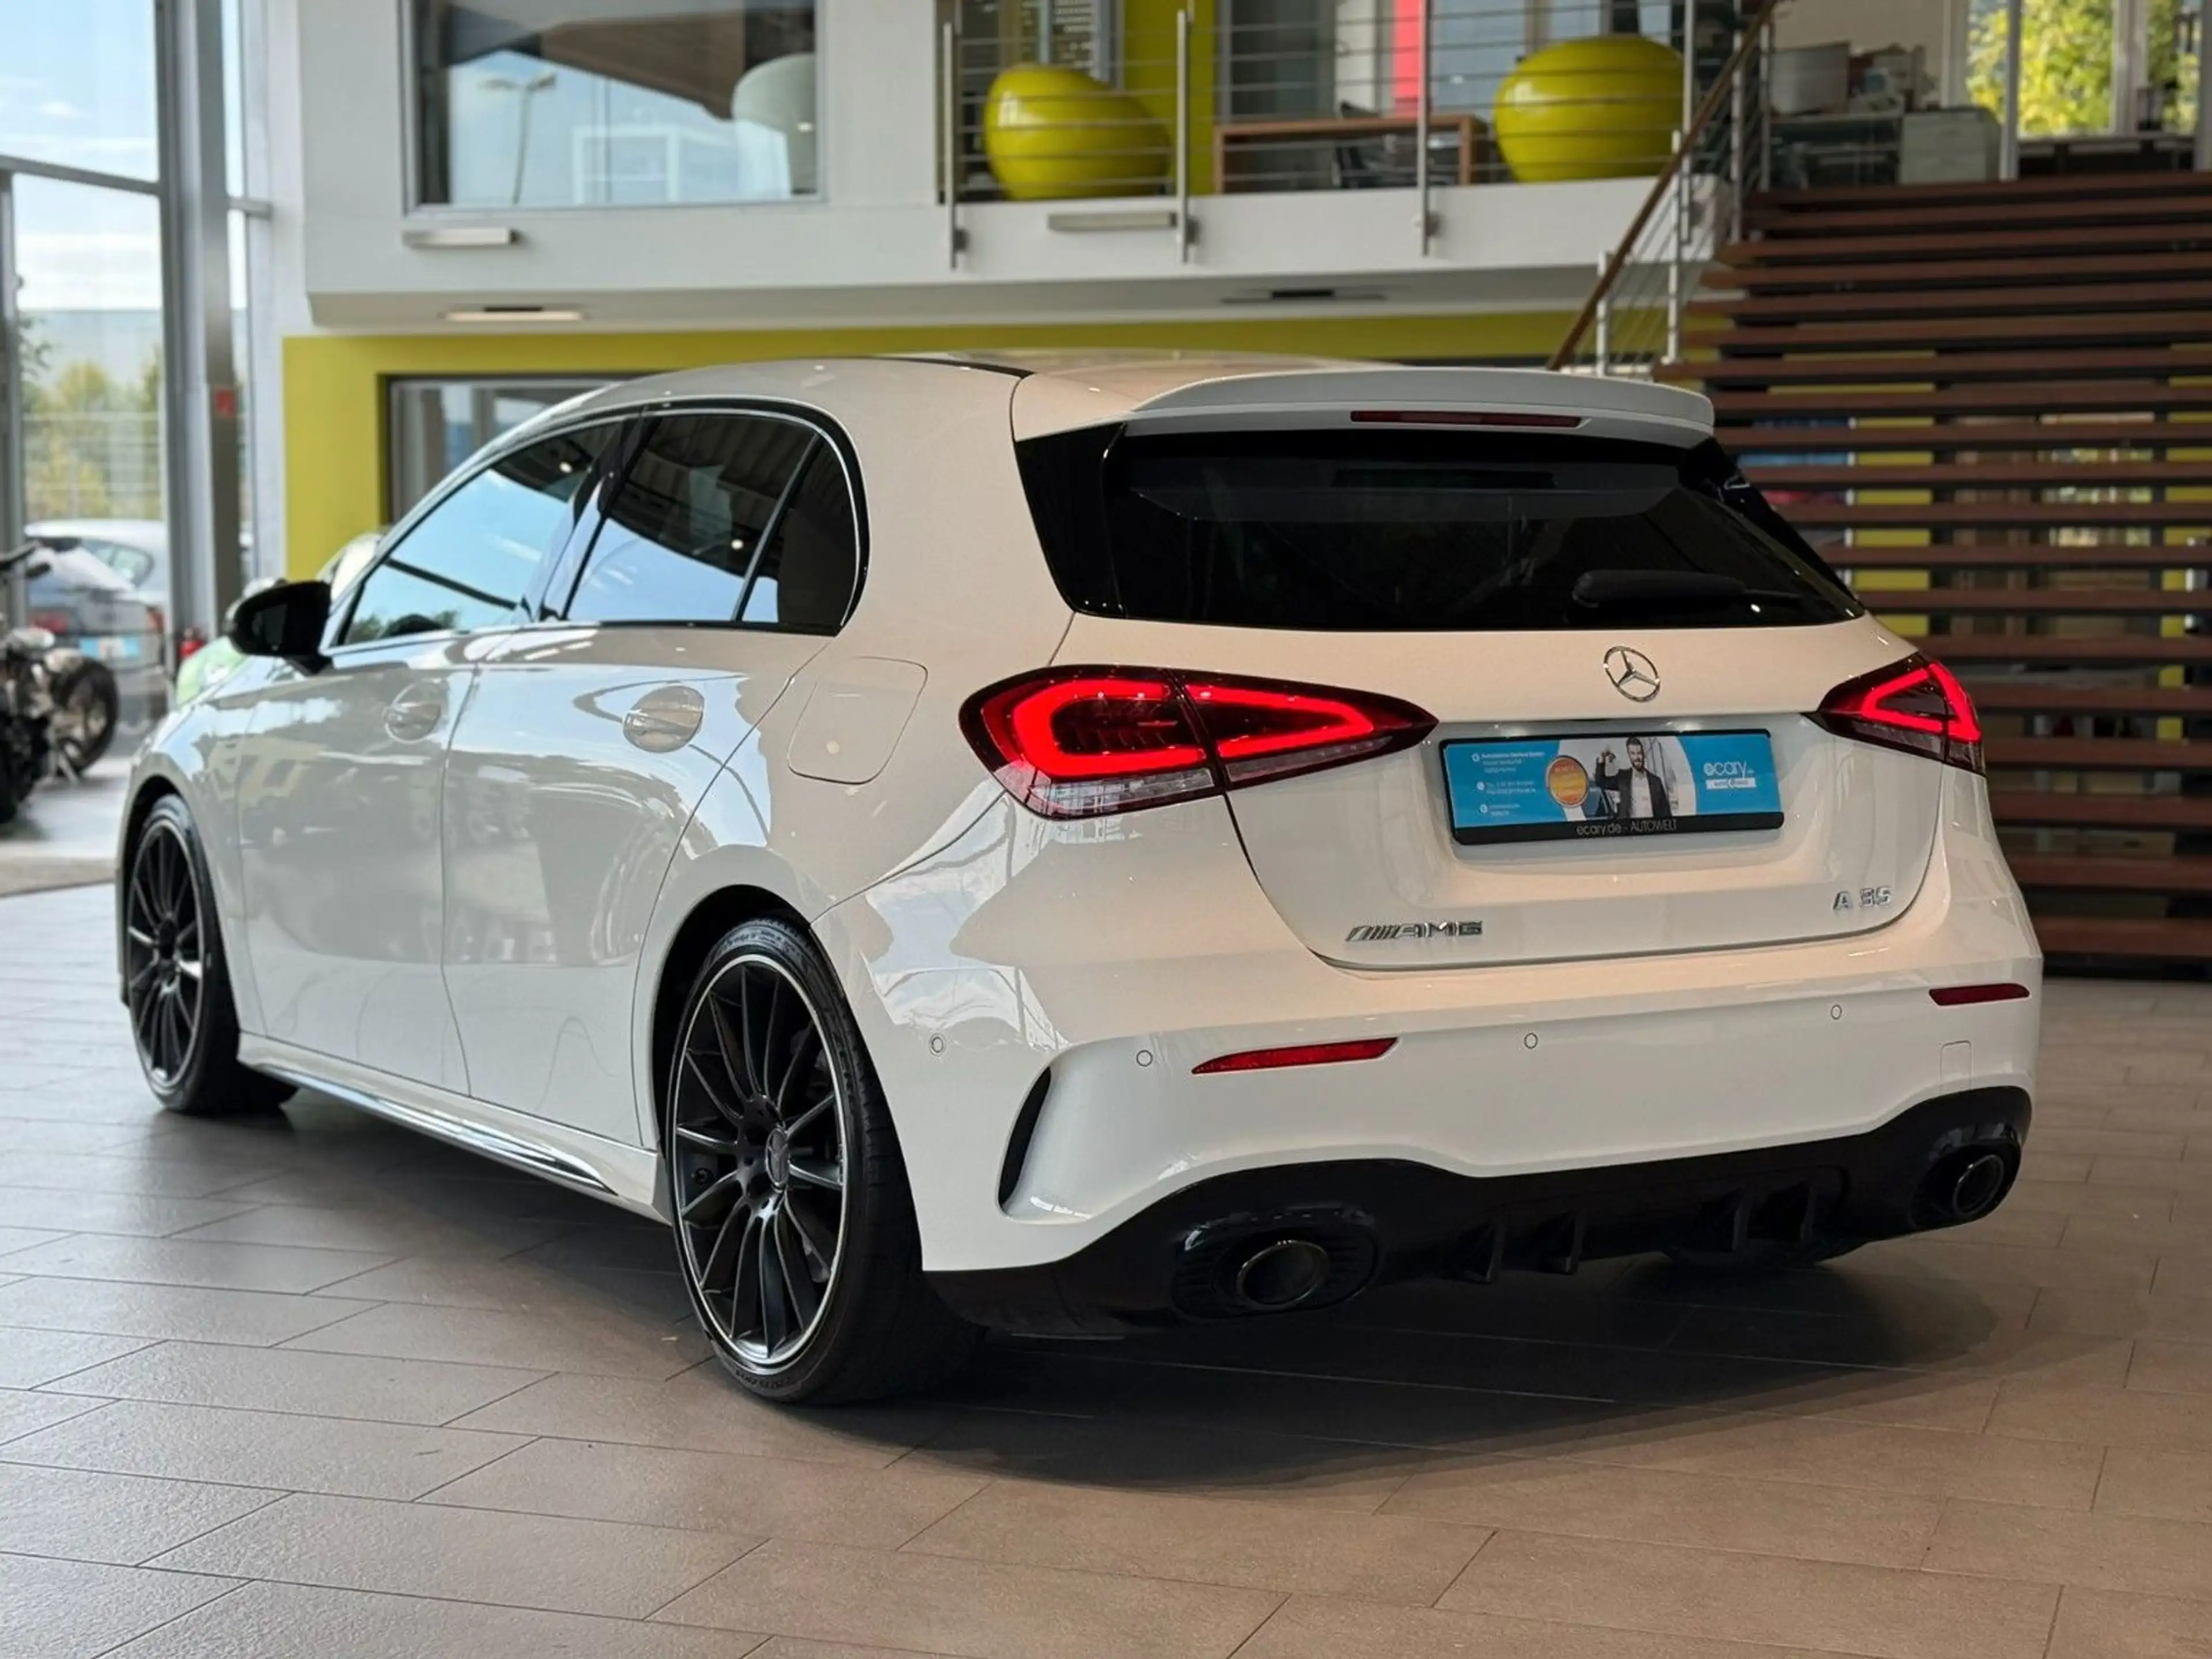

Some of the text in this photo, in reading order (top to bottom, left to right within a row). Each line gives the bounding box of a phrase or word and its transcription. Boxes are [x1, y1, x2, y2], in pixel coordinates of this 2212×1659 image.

[1630, 819, 1677, 832] AUTOWELT
[1832, 885, 1892, 910] A 35
